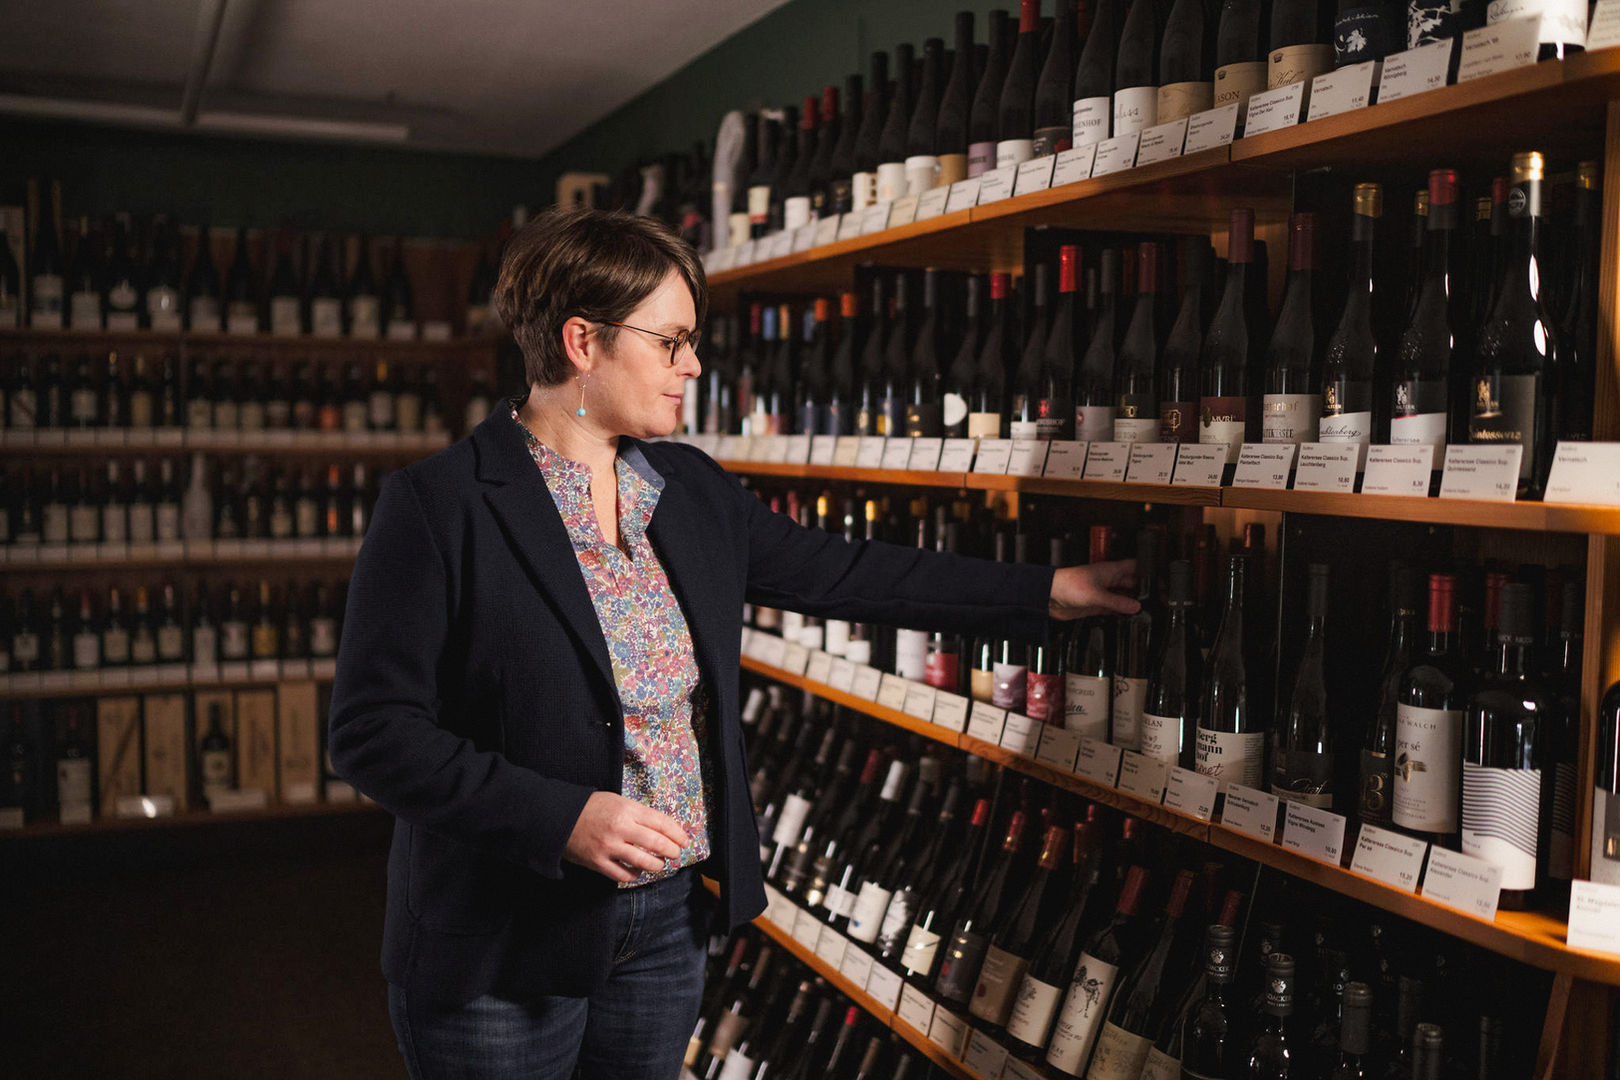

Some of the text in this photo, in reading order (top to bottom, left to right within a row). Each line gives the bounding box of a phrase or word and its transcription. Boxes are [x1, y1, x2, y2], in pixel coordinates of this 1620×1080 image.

[1288, 812, 1309, 822] Kalterersee
[1361, 836, 1384, 847] Kalterersee
[1384, 843, 1403, 853] Classico
